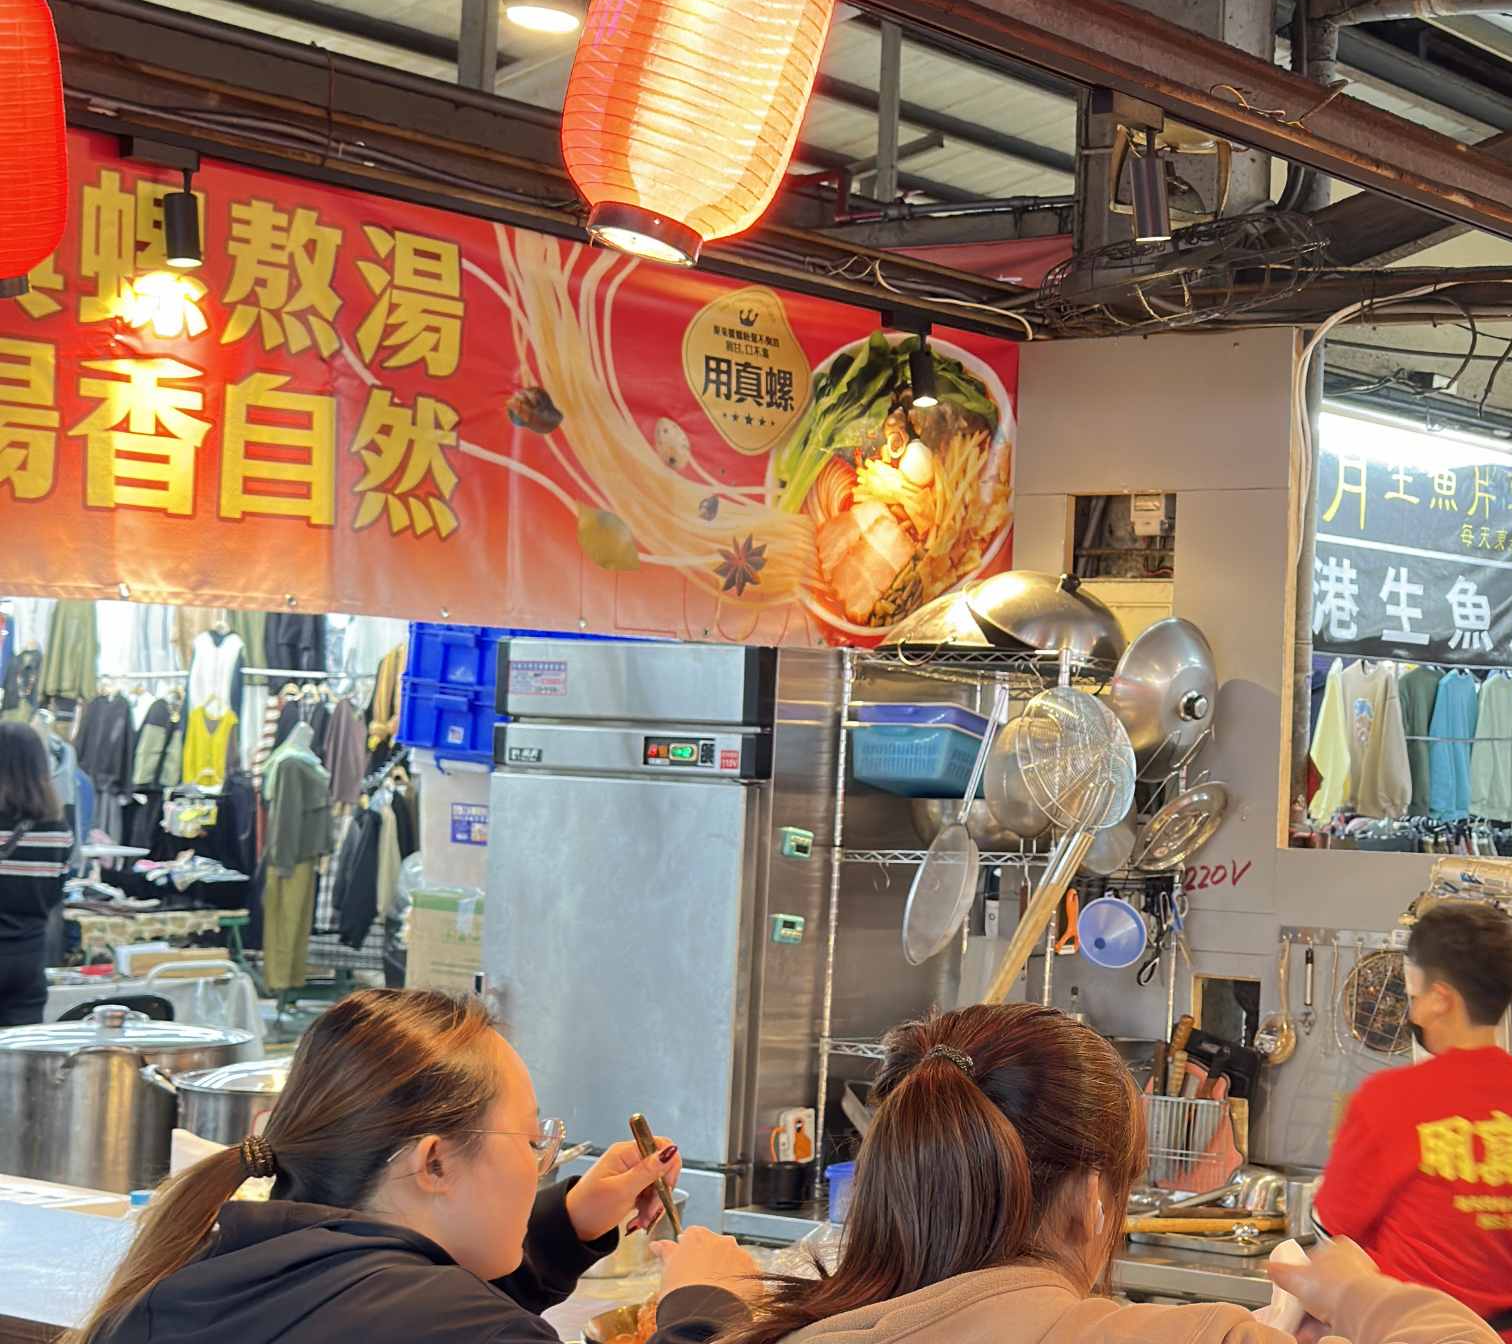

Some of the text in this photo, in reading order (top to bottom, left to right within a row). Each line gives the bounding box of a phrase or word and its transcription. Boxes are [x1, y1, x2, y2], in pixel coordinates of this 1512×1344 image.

[15, 170, 466, 376] 螺熬湯
[703, 354, 794, 412] 用真螺
[1183, 859, 1252, 891] 220V
